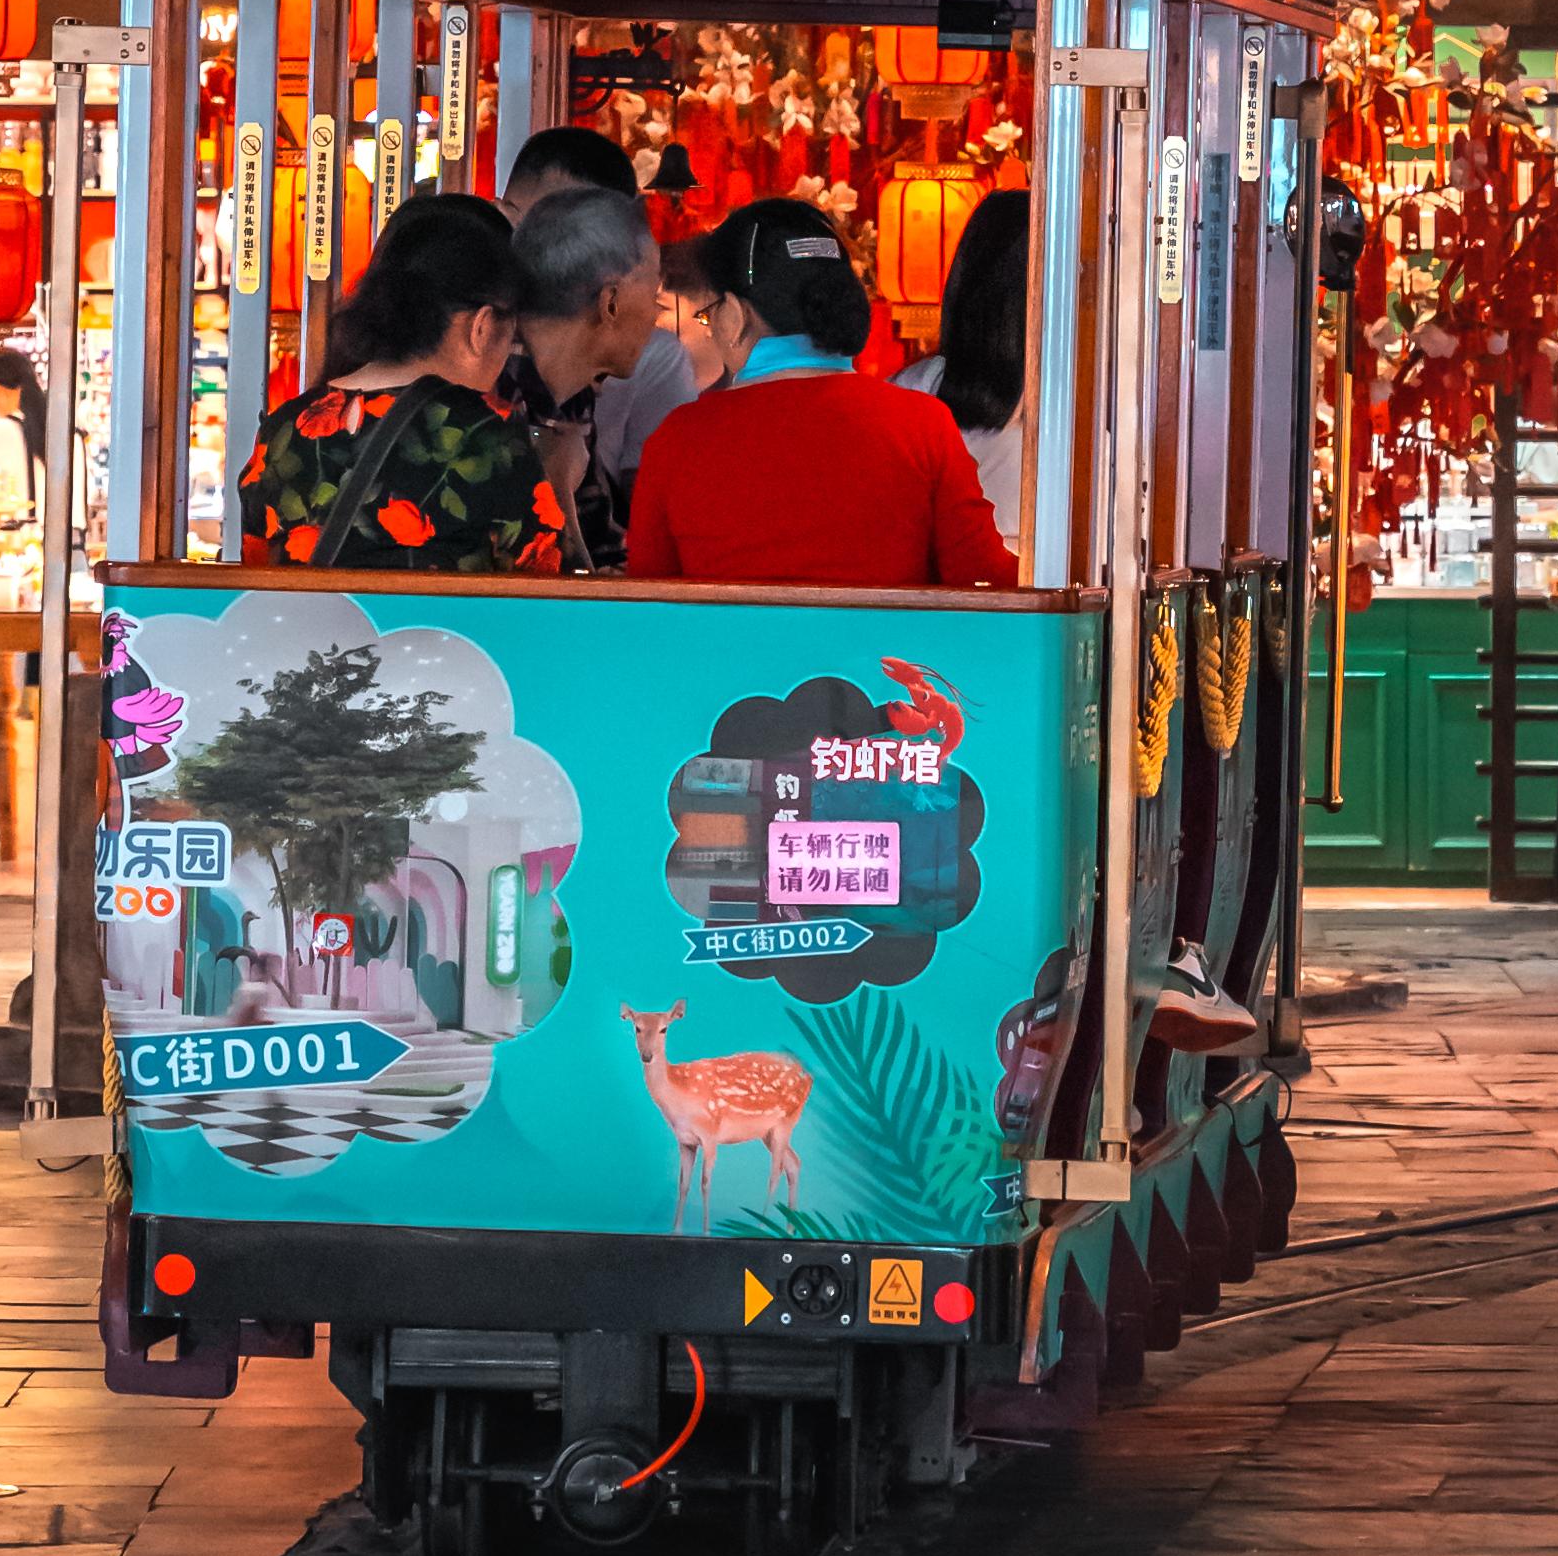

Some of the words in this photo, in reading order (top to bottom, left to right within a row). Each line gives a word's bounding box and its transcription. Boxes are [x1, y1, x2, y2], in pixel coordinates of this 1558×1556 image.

[811, 738, 942, 784] 钓虾馆
[778, 832, 890, 859] 车辆行驶
[778, 866, 890, 893] 请勿尾随
[705, 925, 848, 956] 中C街D002
